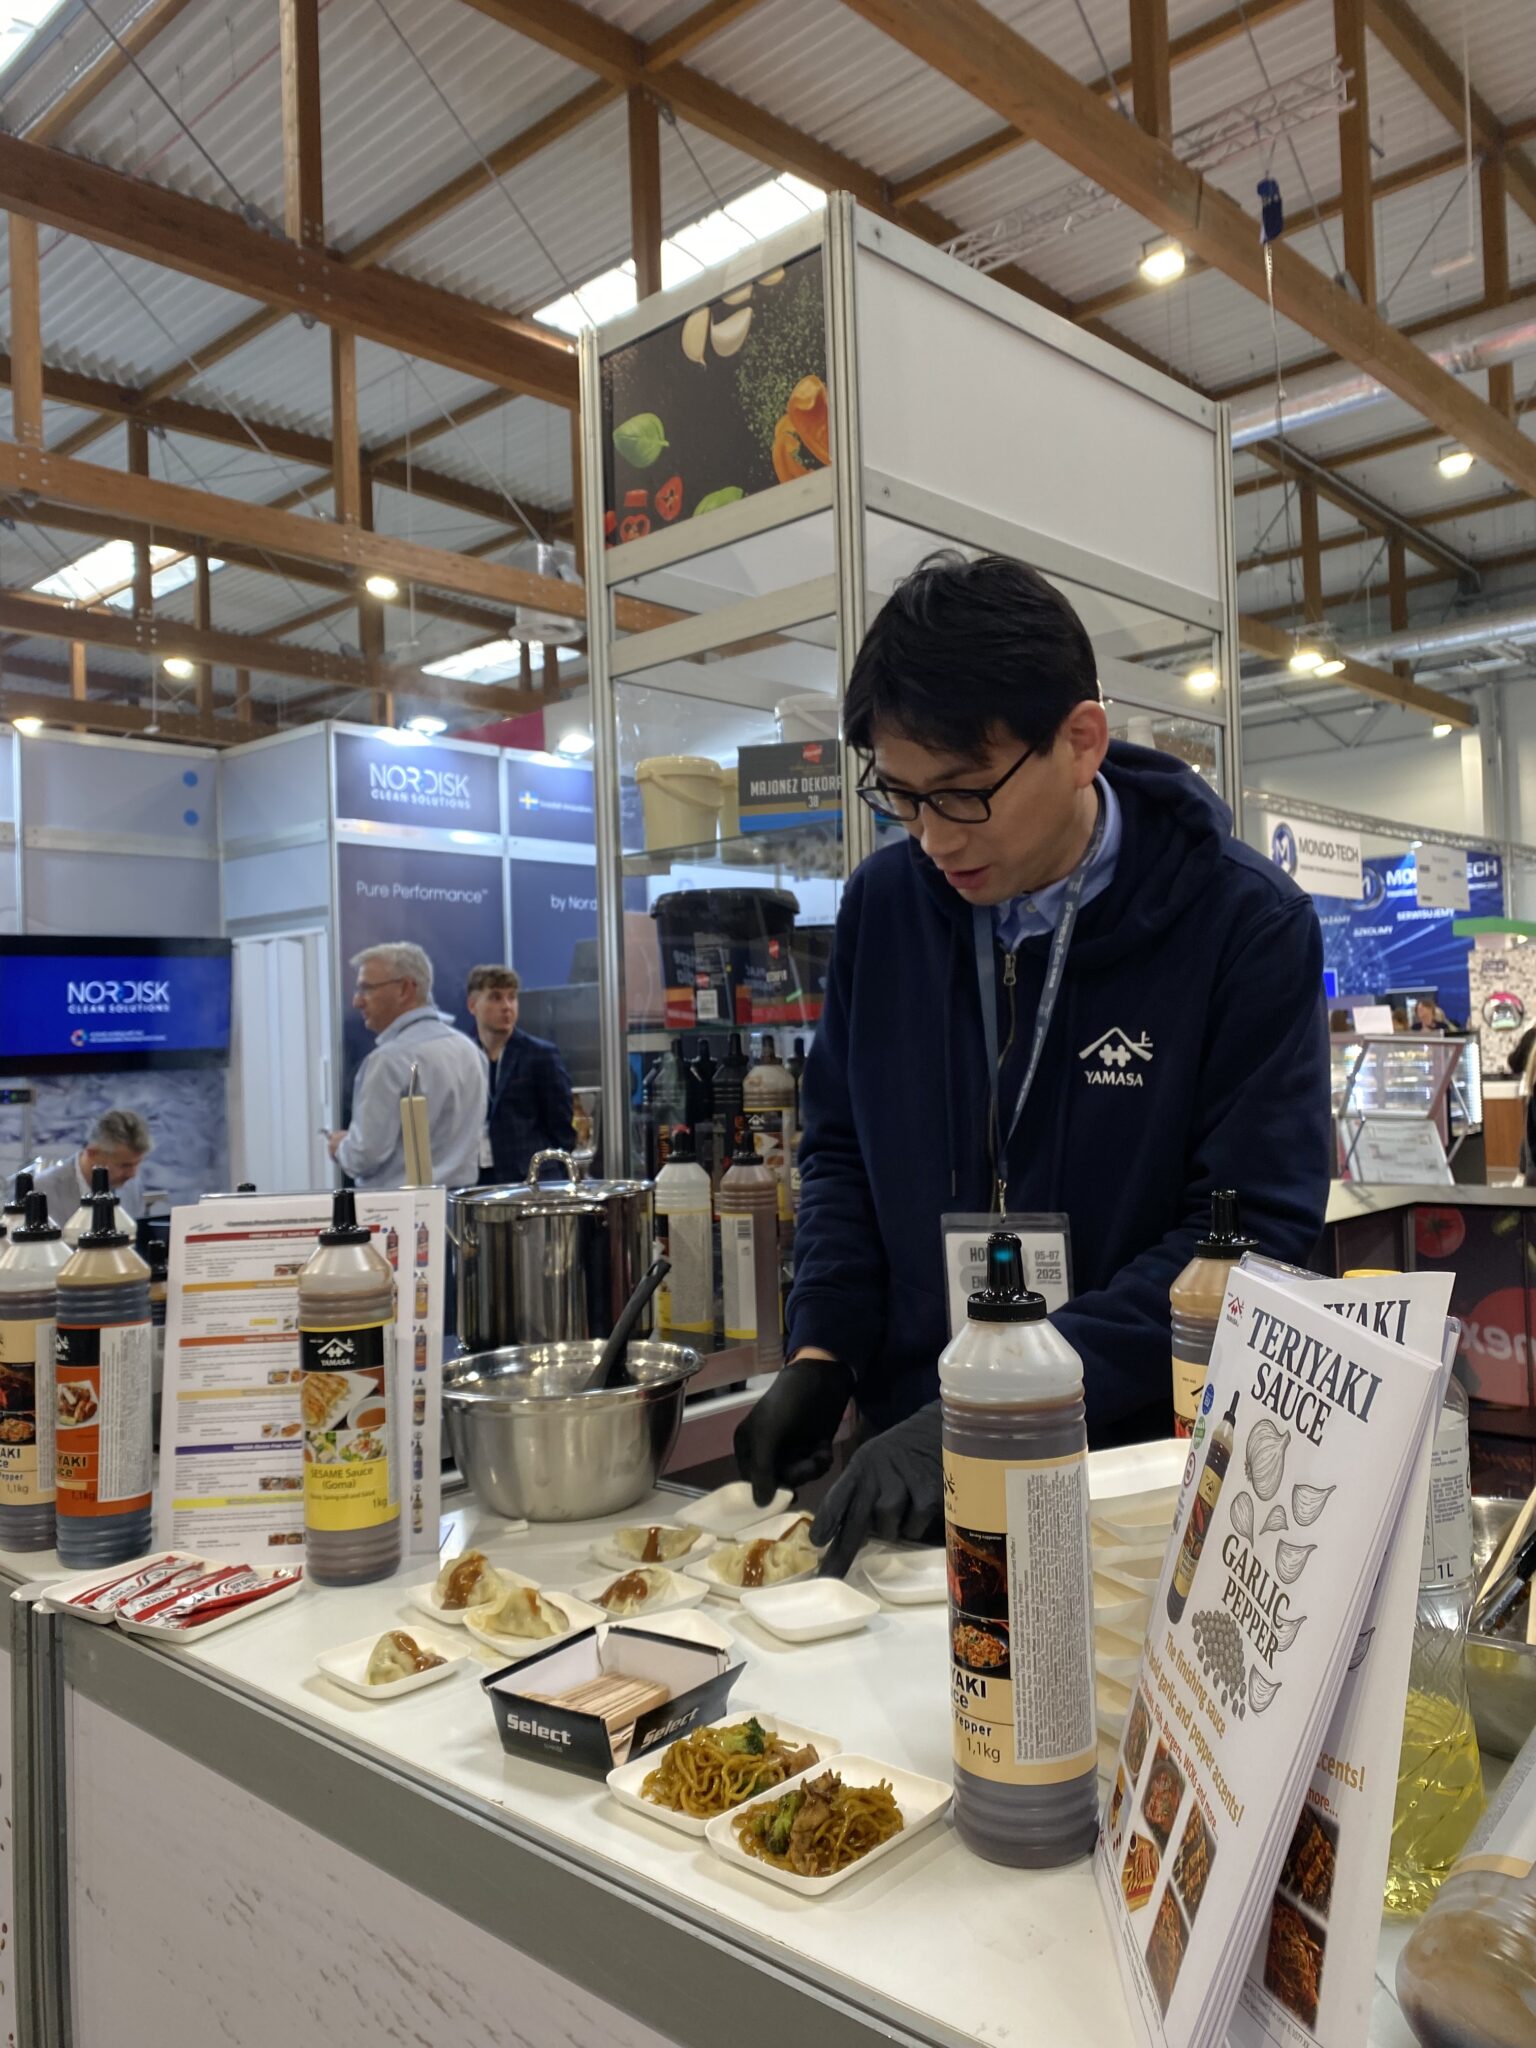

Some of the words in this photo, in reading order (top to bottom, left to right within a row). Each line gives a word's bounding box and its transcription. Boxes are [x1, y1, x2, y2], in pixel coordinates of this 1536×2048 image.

[369, 762, 470, 798] NORDISK
[750, 778, 798, 797] MAJONEZ
[371, 789, 411, 803] CLEAN
[412, 793, 471, 810] SOLUTIONS
[1299, 837, 1359, 863] MONDO-TECH
[356, 880, 390, 899] Pure
[550, 894, 566, 911] by
[67, 980, 170, 1004] NORDISK
[67, 1003, 106, 1015] CLEAN
[108, 1001, 170, 1015] SOLUTIONS
[1084, 1069, 1144, 1088] YAMASA
[1036, 1268, 1063, 1281] 2025
[1246, 1306, 1384, 1425] TERIYAKI
[1250, 1362, 1332, 1448] SAUCE
[309, 1467, 343, 1480] SESAME
[345, 1466, 374, 1479] Sauce
[1221, 1533, 1291, 1630] GARLIC
[1221, 1575, 1281, 1670] PEPPER
[1165, 1630, 1178, 1662] The
[1176, 1649, 1209, 1712] finishing
[1205, 1697, 1226, 1740] sauce
[506, 1712, 572, 1746] Select
[639, 1706, 700, 1749] Select
[966, 1737, 1001, 1764] 1,1kg
[1157, 1673, 1178, 1709] garlic
[1175, 1700, 1192, 1731] and
[1188, 1721, 1216, 1773] pepper
[1211, 1764, 1245, 1828] accents!
[1162, 1721, 1183, 1764] Burgers,
[1183, 1752, 1199, 1789] WOKs
[1195, 1781, 1208, 1807] and
